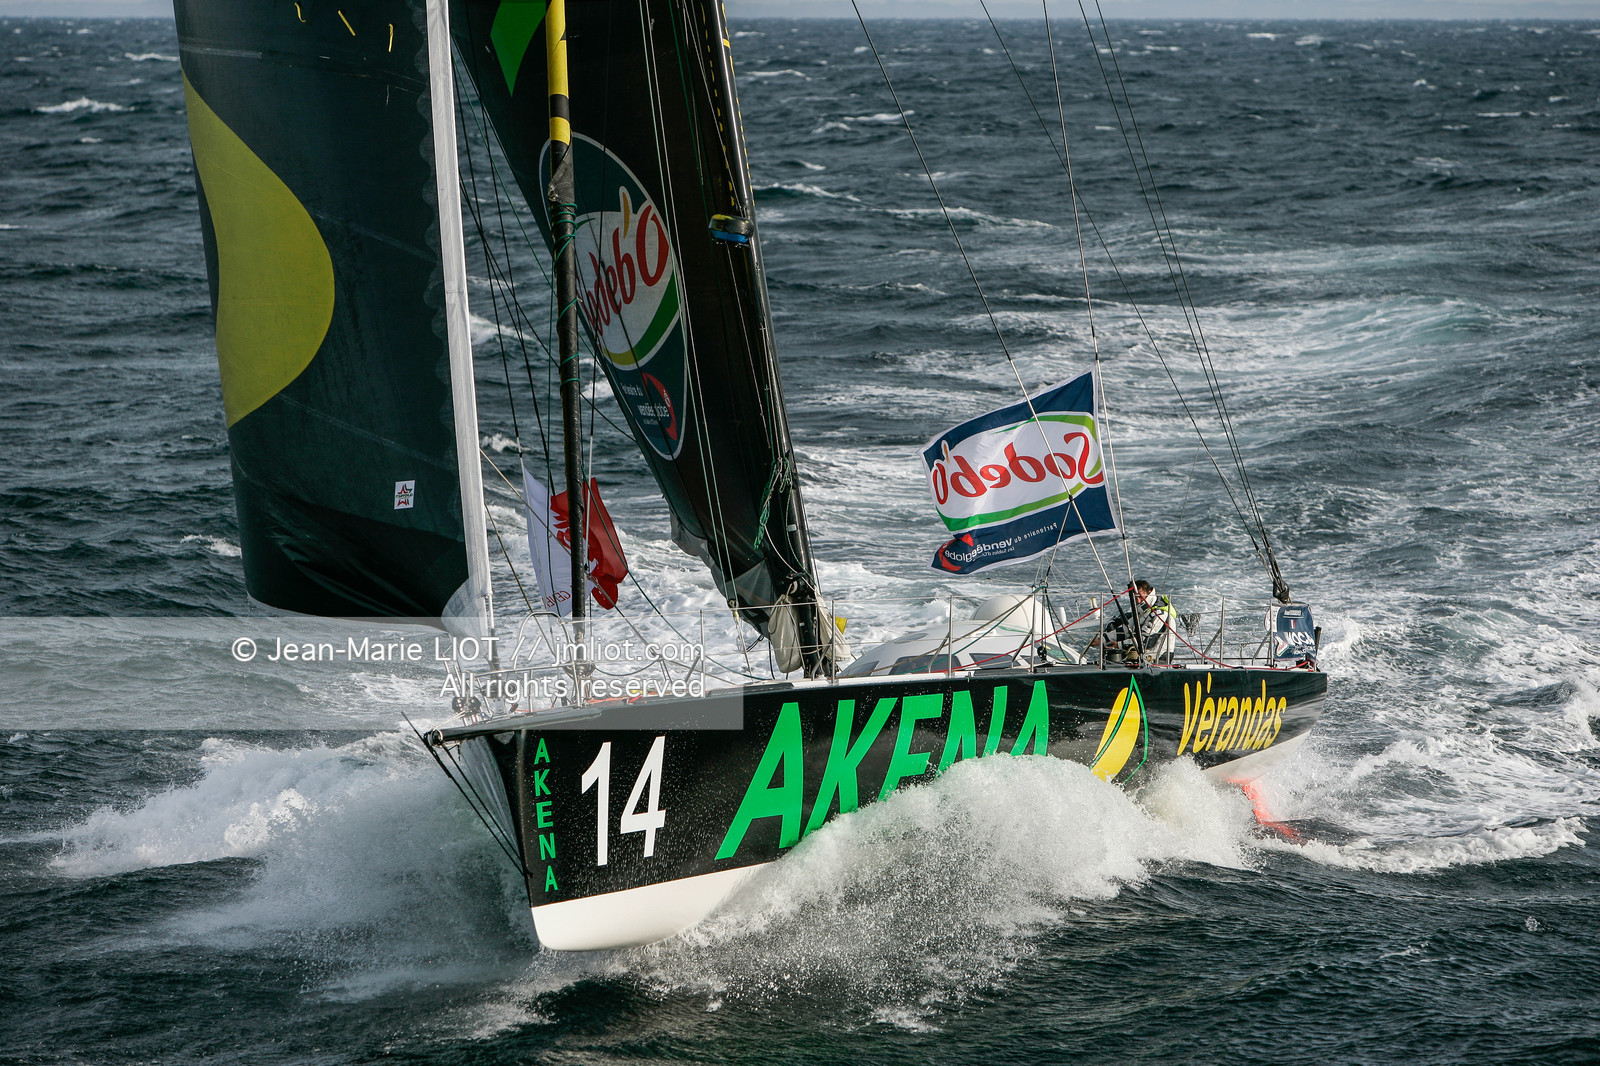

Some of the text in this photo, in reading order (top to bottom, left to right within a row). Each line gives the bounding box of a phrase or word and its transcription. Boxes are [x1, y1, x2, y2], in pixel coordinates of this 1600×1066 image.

[714, 680, 1050, 860] AKENA
[1177, 672, 1287, 756] Vérandas
[533, 737, 559, 893] AKENA
[581, 735, 667, 867] 14
